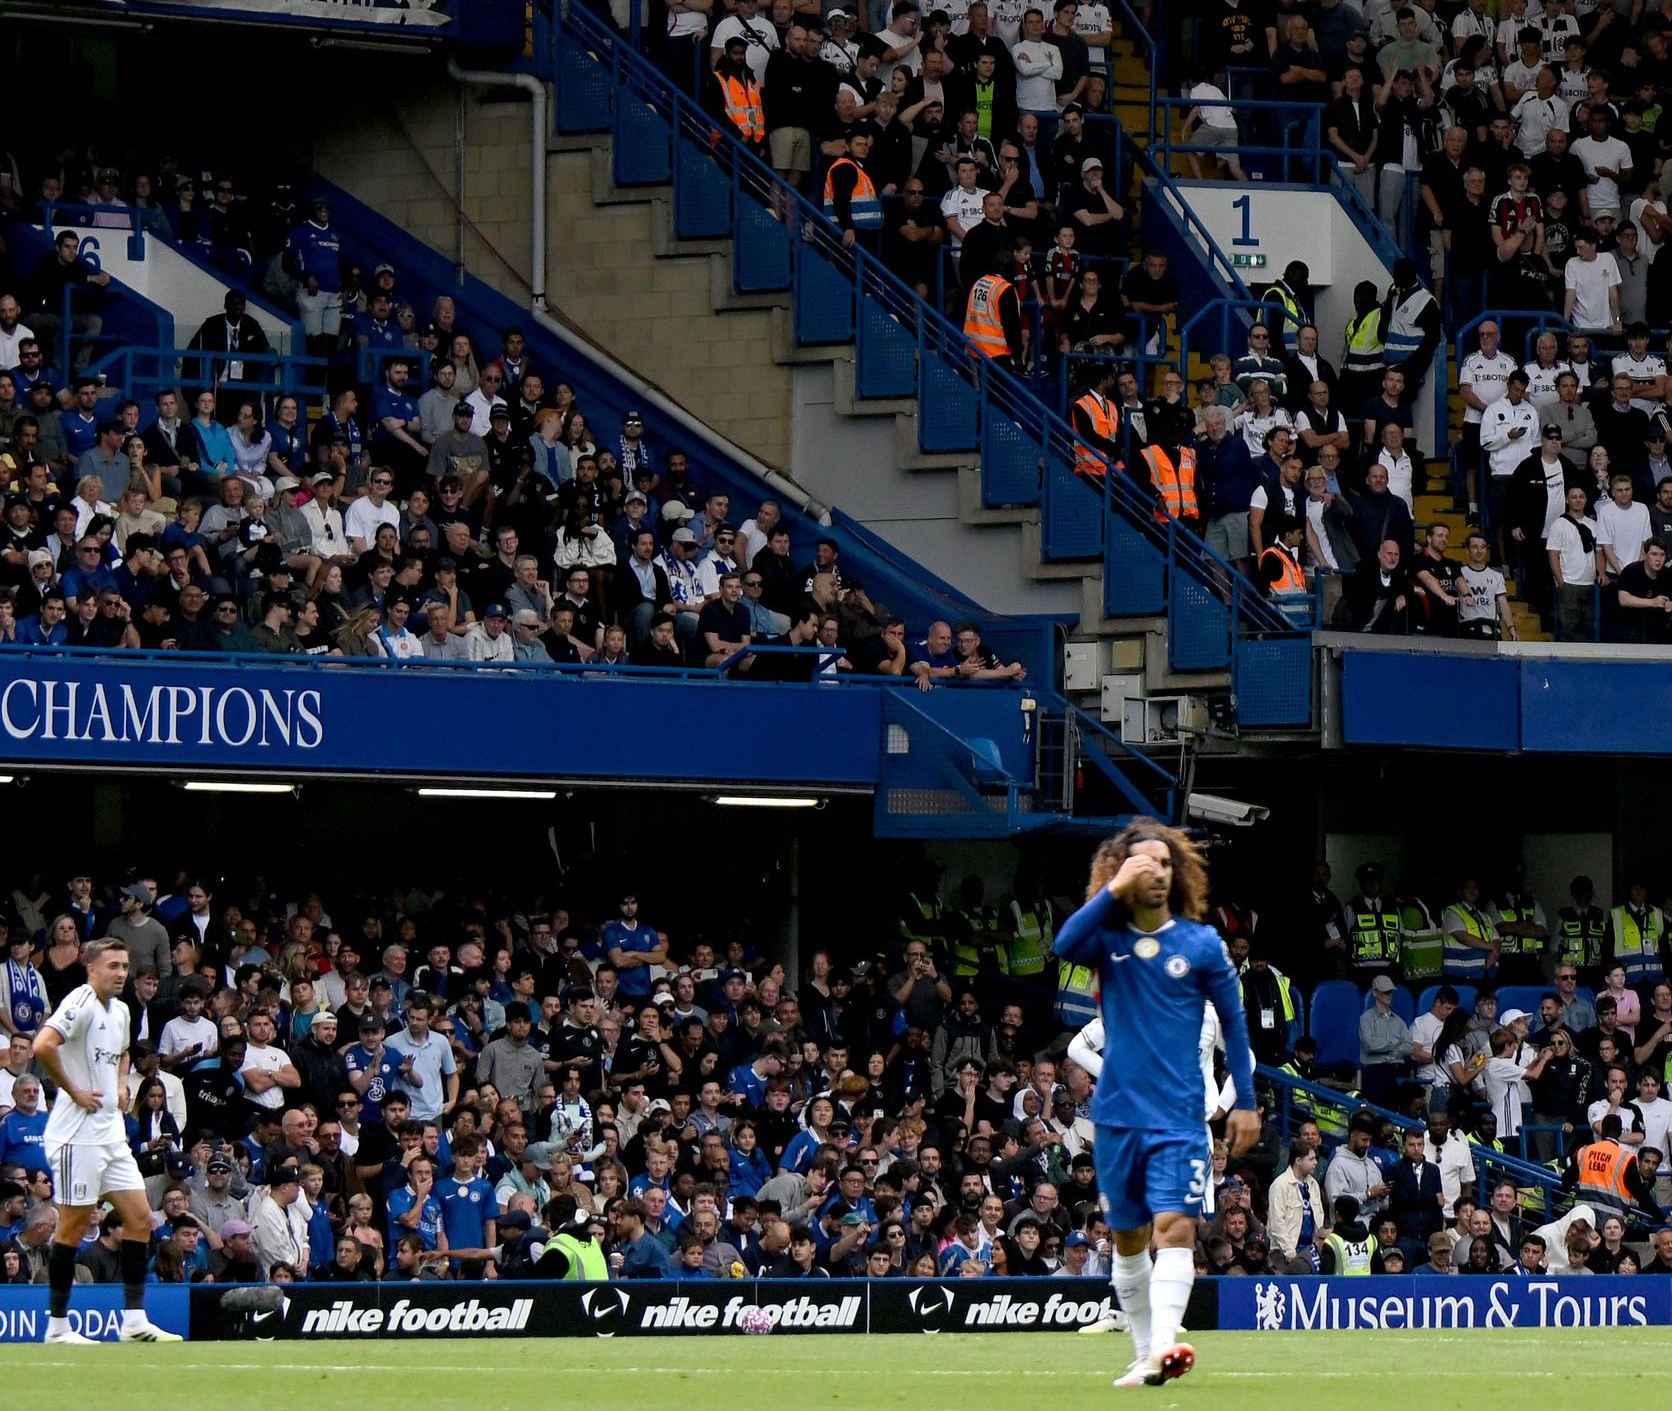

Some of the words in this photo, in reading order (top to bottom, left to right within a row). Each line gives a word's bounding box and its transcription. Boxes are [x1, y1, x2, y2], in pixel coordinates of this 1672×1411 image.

[1231, 195, 1260, 247] 1
[973, 287, 988, 303] 126
[1, 678, 324, 749] CHAMPIONS
[1588, 1149, 1612, 1163] PITCH
[1588, 1160, 1608, 1173] LEAD
[1187, 1158, 1205, 1194] 3
[1344, 1242, 1370, 1257] 134
[301, 1300, 383, 1334] nike
[387, 1297, 536, 1333] football
[640, 1296, 719, 1328] nike
[964, 1294, 1040, 1326] nike
[1042, 1291, 1116, 1325] foot
[1290, 1282, 1476, 1329] Museum
[1485, 1280, 1523, 1329] &
[1529, 1281, 1649, 1328] Tours
[45, 1308, 127, 1338] ODA
